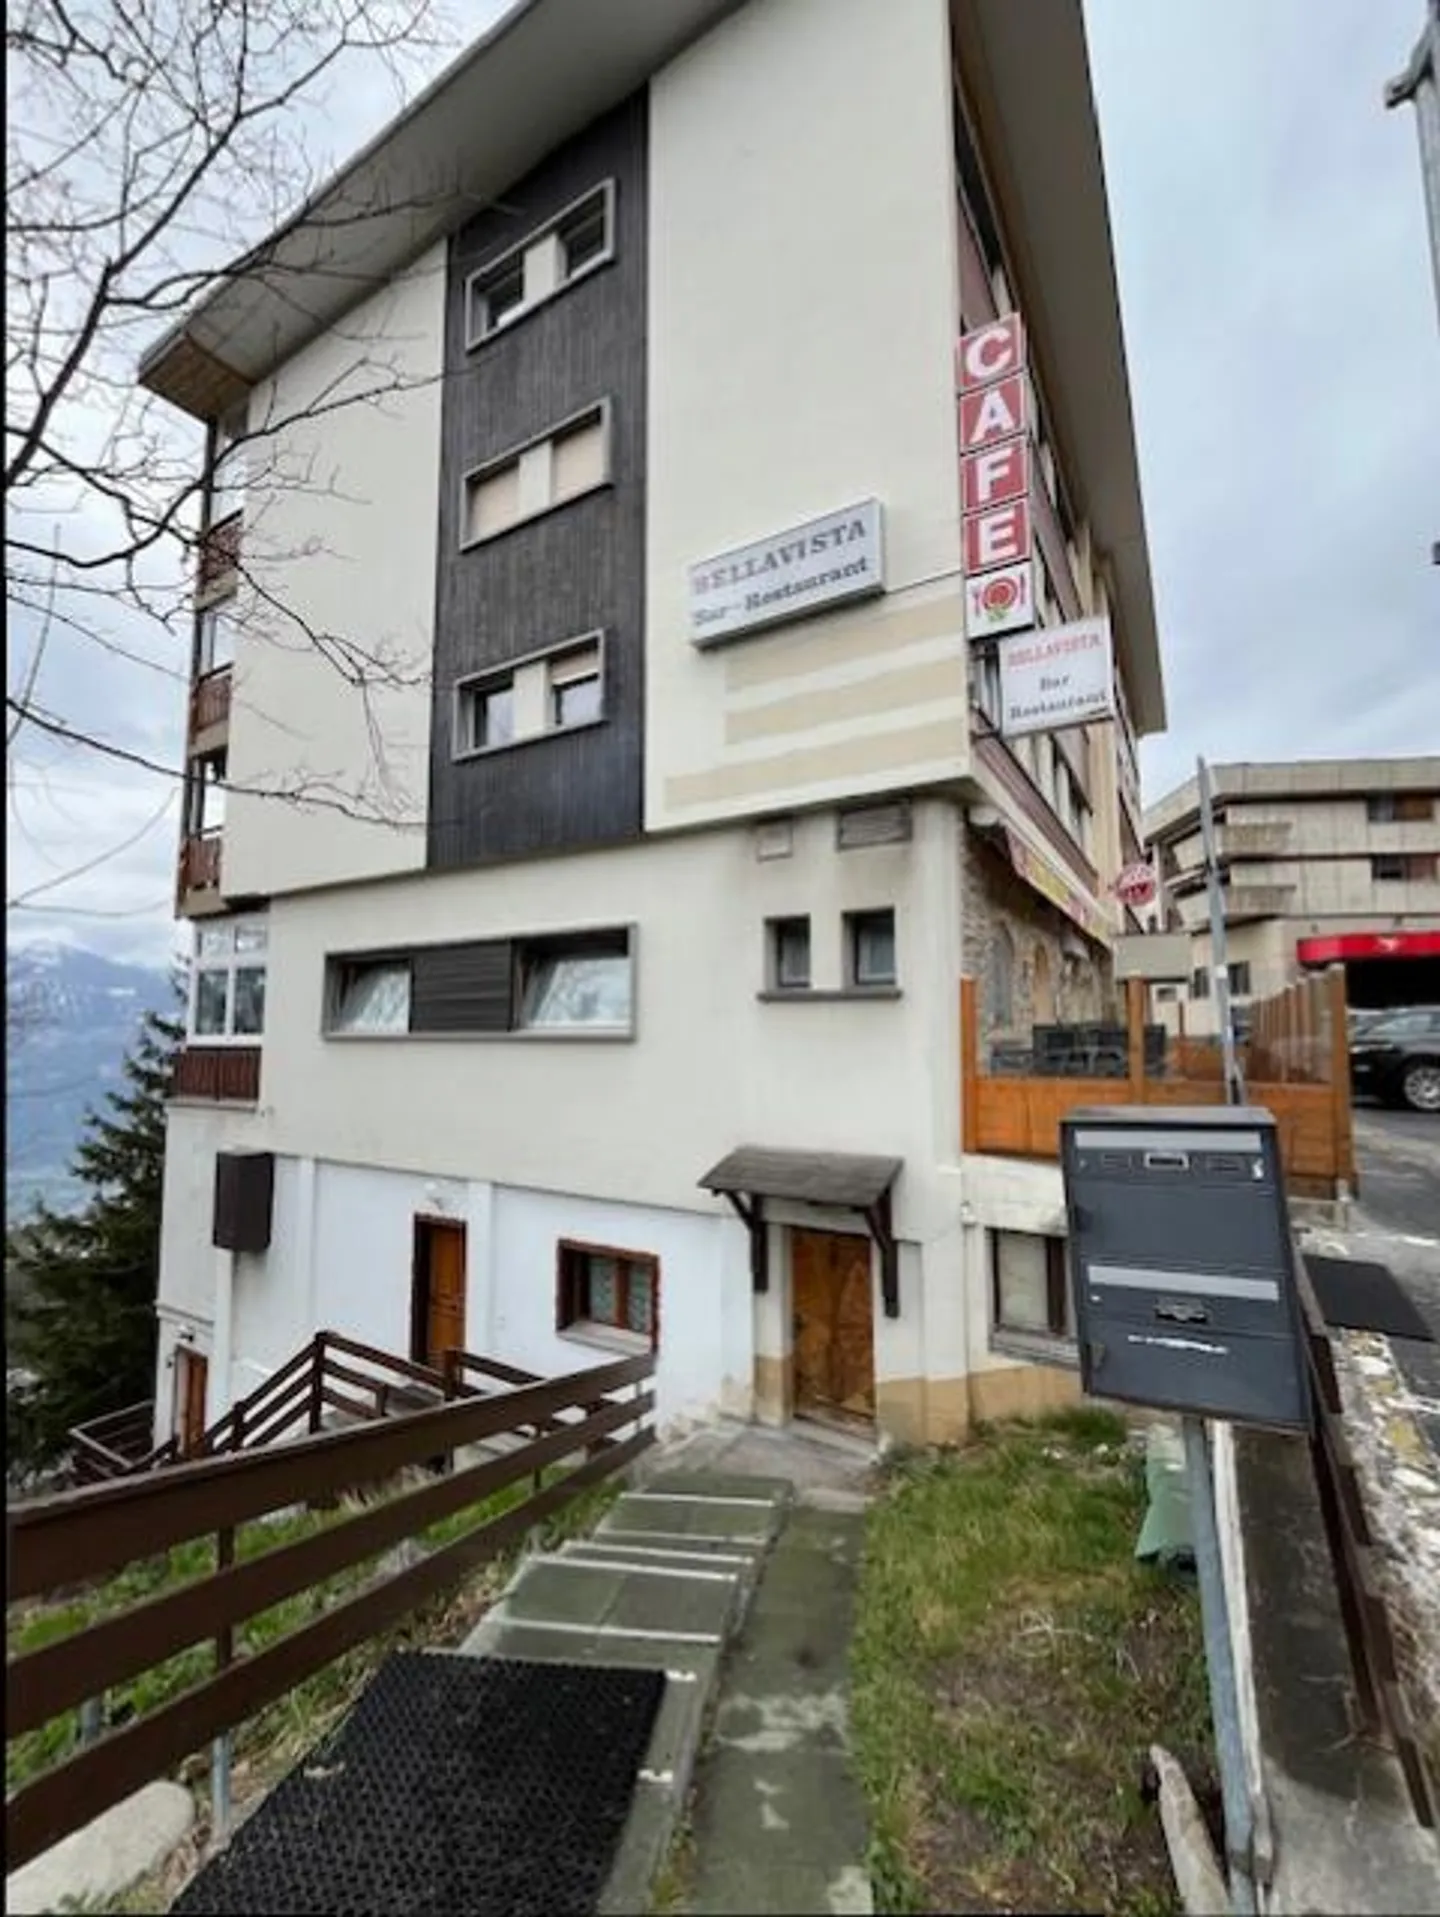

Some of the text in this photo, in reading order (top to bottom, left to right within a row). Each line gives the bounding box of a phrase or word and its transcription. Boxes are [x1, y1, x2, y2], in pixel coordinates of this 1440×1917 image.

[965, 327, 1018, 566] CAFE
[692, 519, 867, 596] BELLAVISTA
[1010, 691, 1107, 719] Restaurant
[1040, 675, 1070, 691] Bar
